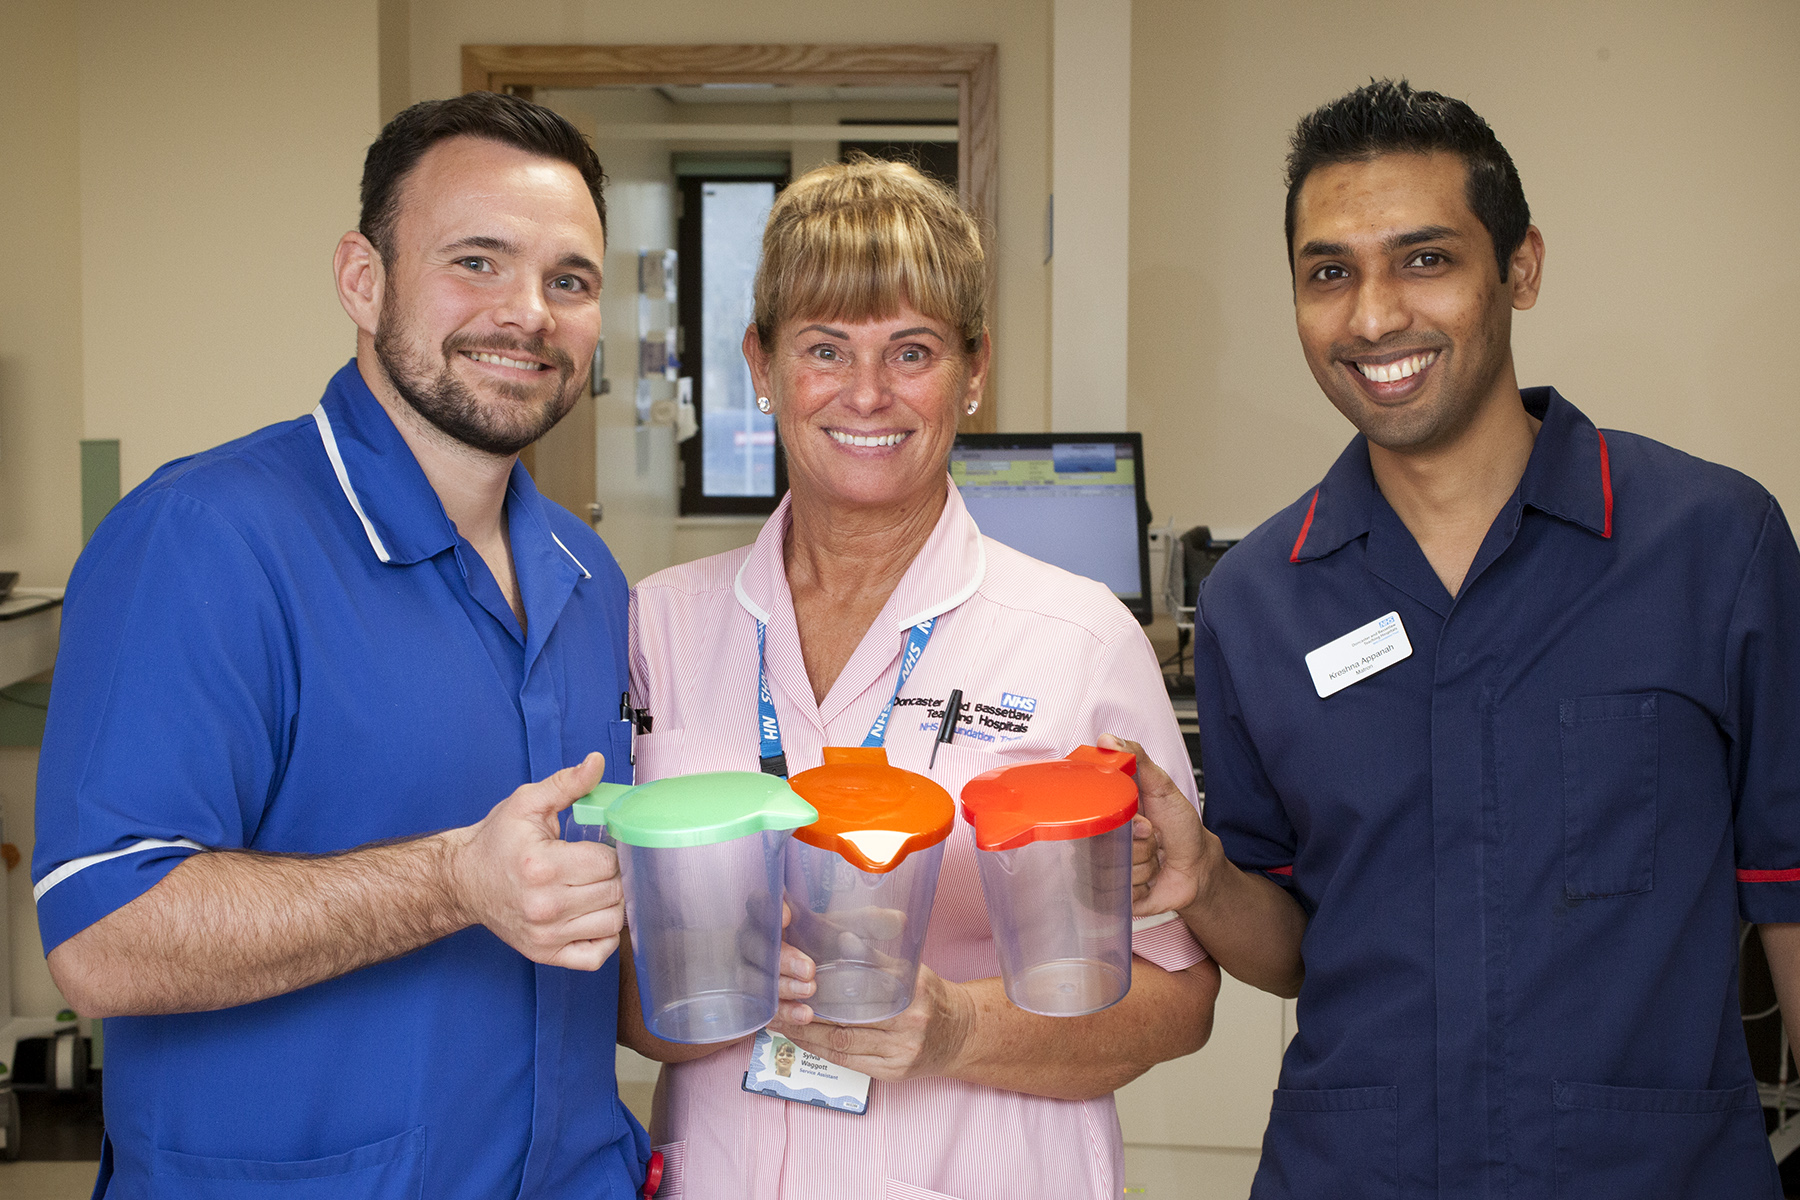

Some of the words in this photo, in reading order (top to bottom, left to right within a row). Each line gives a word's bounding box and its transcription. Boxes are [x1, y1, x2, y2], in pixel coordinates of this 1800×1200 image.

[901, 642, 921, 682] NHS
[1328, 661, 1360, 680] Kreshna
[1361, 644, 1395, 665] Appanah
[893, 696, 944, 708] Doncaster
[974, 703, 1033, 722] Bassetlaw
[1003, 694, 1036, 711] NHS
[762, 715, 779, 741] NH
[870, 702, 892, 738] NHS
[919, 722, 939, 731] NHS
[979, 714, 1029, 733] Hospitals
[799, 1067, 817, 1076] Service
[817, 1071, 838, 1080] Assistant
[801, 1060, 828, 1071] Waggott
